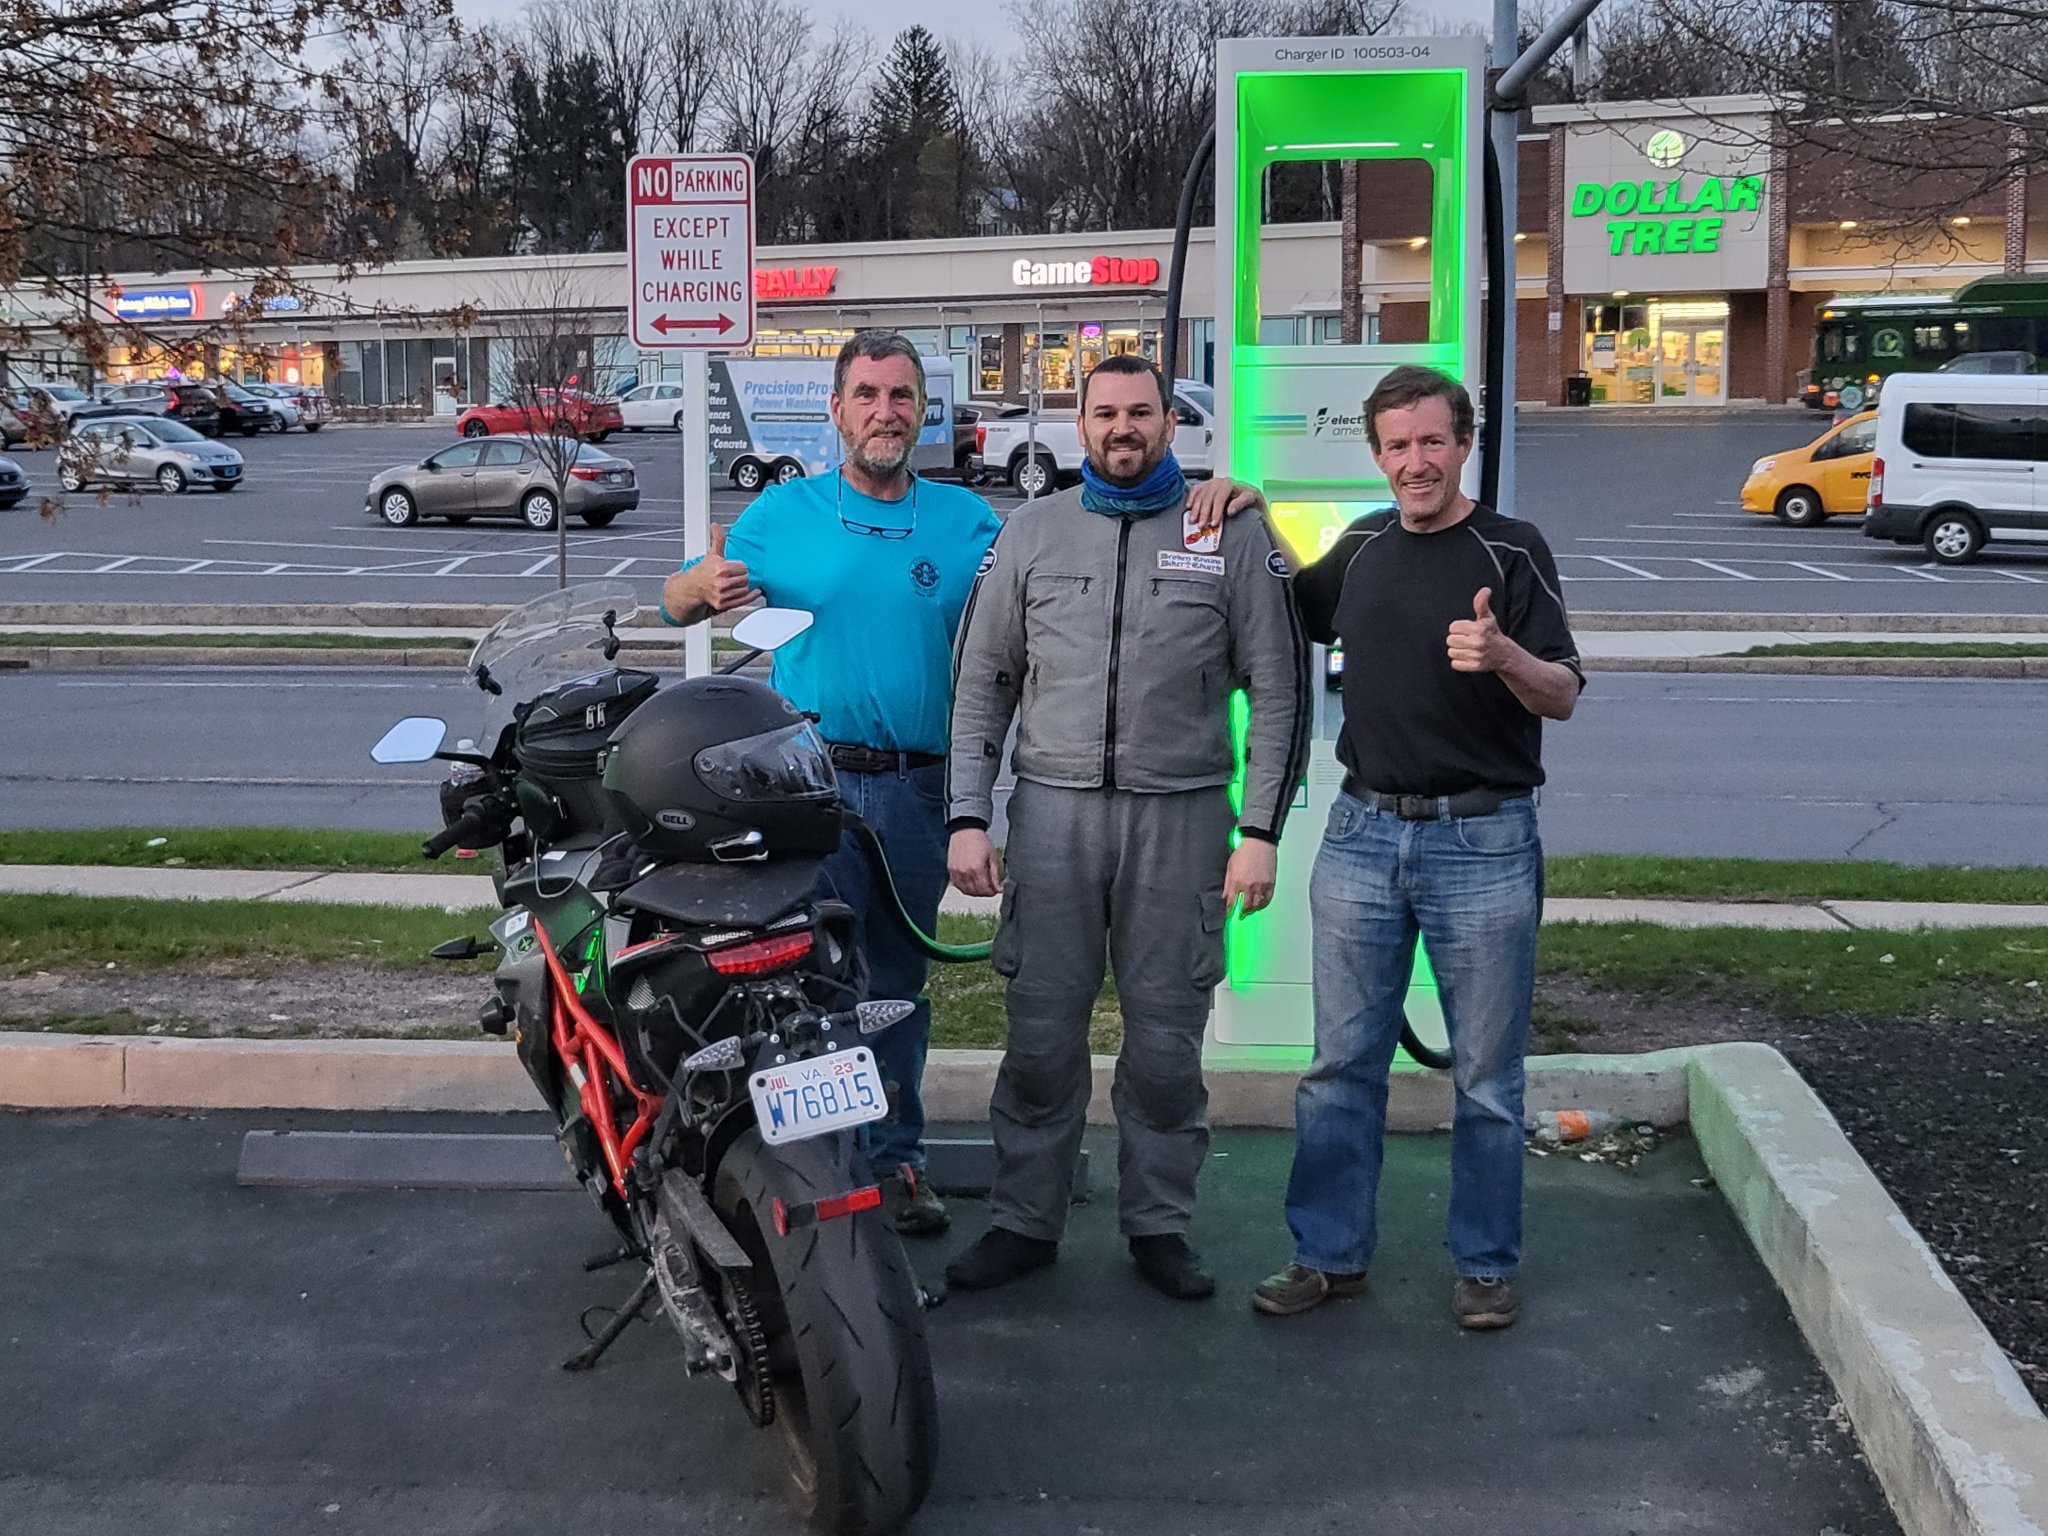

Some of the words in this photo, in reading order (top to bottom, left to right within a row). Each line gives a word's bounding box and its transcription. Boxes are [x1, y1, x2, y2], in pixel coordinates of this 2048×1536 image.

[1274, 48, 1328, 63] Charger
[1330, 48, 1345, 59] ID
[1353, 46, 1430, 59] 100503-04
[637, 166, 669, 198] NO
[675, 169, 744, 193] PARKING
[1571, 176, 1762, 217] DOLLAR
[653, 217, 730, 239] EXCEPT
[1606, 217, 1723, 256] TREE
[660, 249, 723, 271] WHILE
[754, 264, 838, 291] SALLY
[1012, 255, 1160, 286] GameStop
[642, 280, 743, 303] CHARGING
[744, 380, 805, 395] Precision
[708, 396, 728, 406] tters
[753, 396, 784, 409] Power
[786, 396, 827, 411] Washing
[708, 411, 731, 420] ences
[1331, 415, 1362, 425] elect
[709, 423, 733, 434] Decks
[1332, 427, 1363, 436] amer
[713, 439, 748, 449] Concrete
[662, 814, 689, 825] BELL
[769, 1076, 790, 1091] JUL
[833, 1062, 854, 1076] 23
[765, 1072, 875, 1129] W76815
